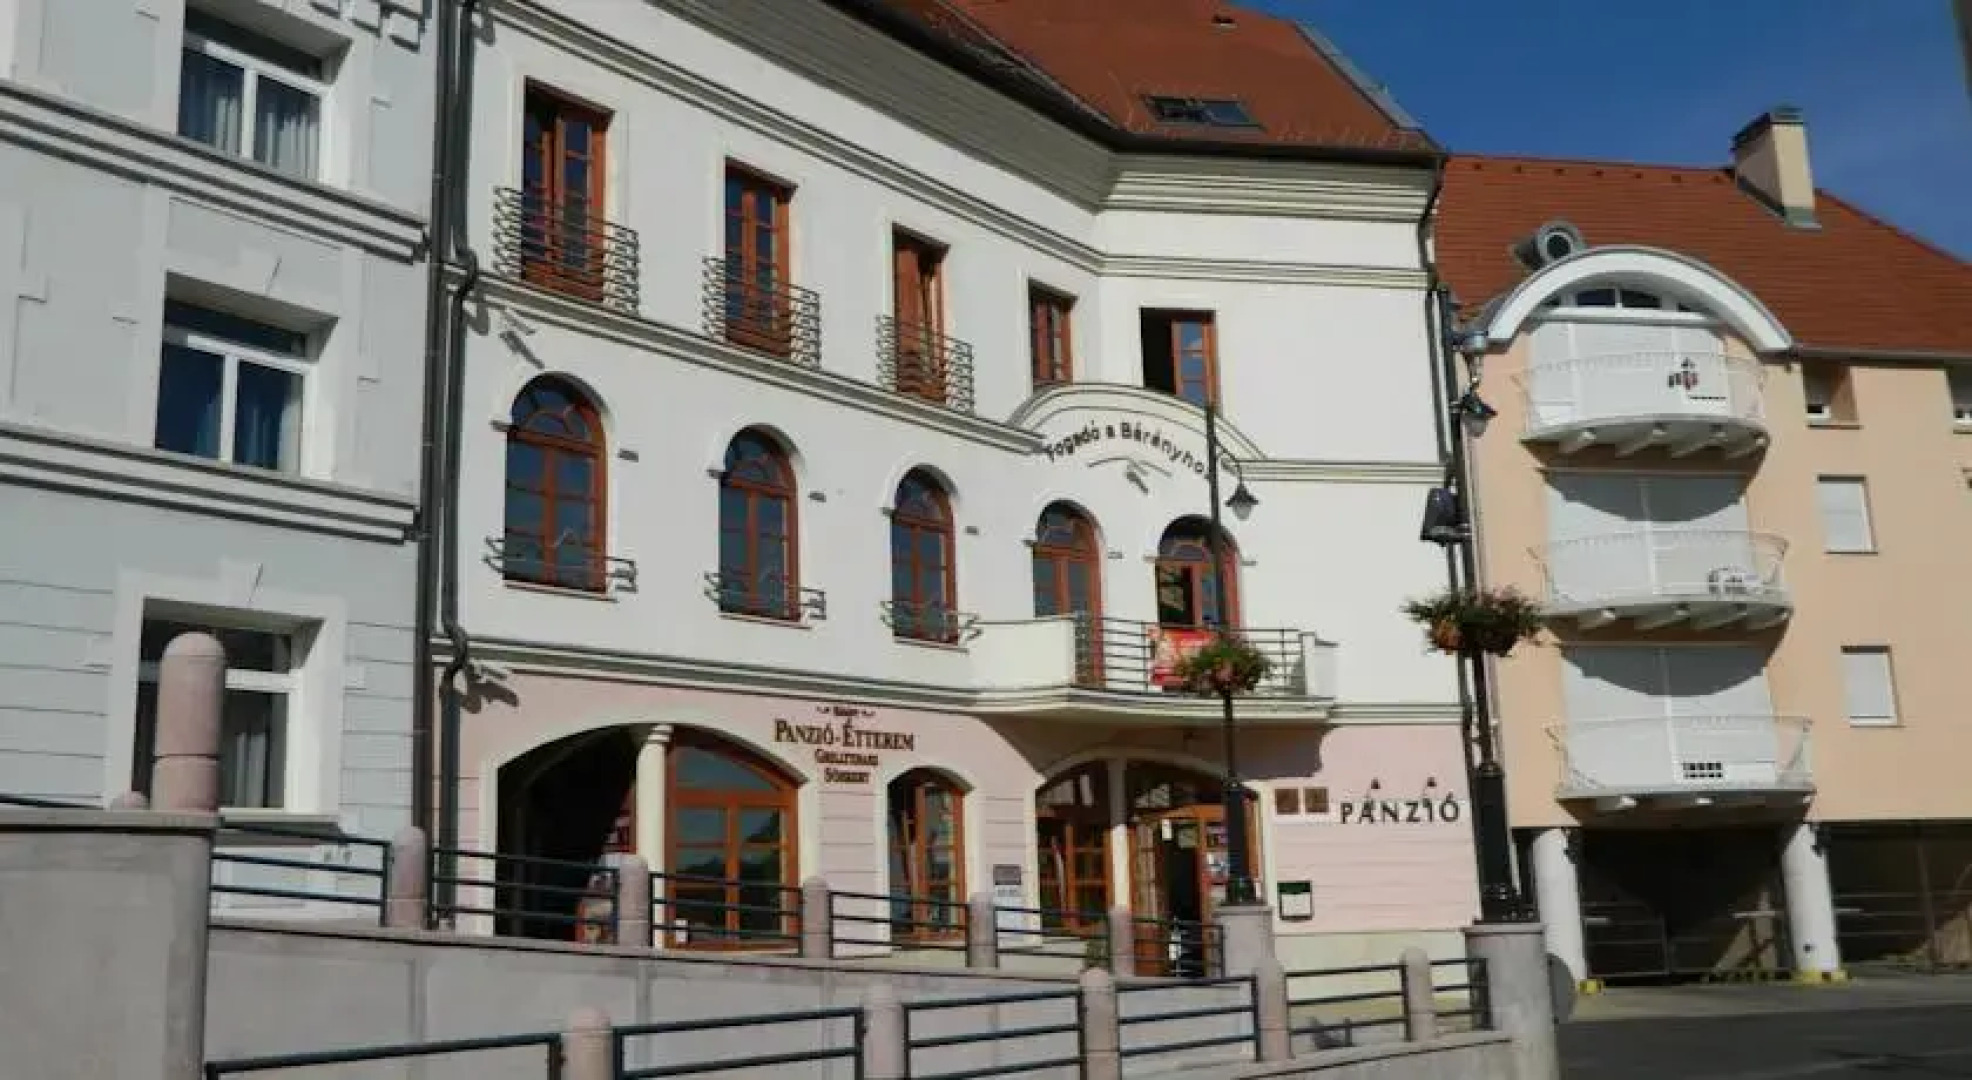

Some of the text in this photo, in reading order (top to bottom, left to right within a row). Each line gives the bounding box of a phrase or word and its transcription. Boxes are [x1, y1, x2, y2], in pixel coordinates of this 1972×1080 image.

[1106, 424, 1115, 439] a
[1121, 420, 1210, 480] Bárányho
[1340, 791, 1459, 824] PANZIÓ
